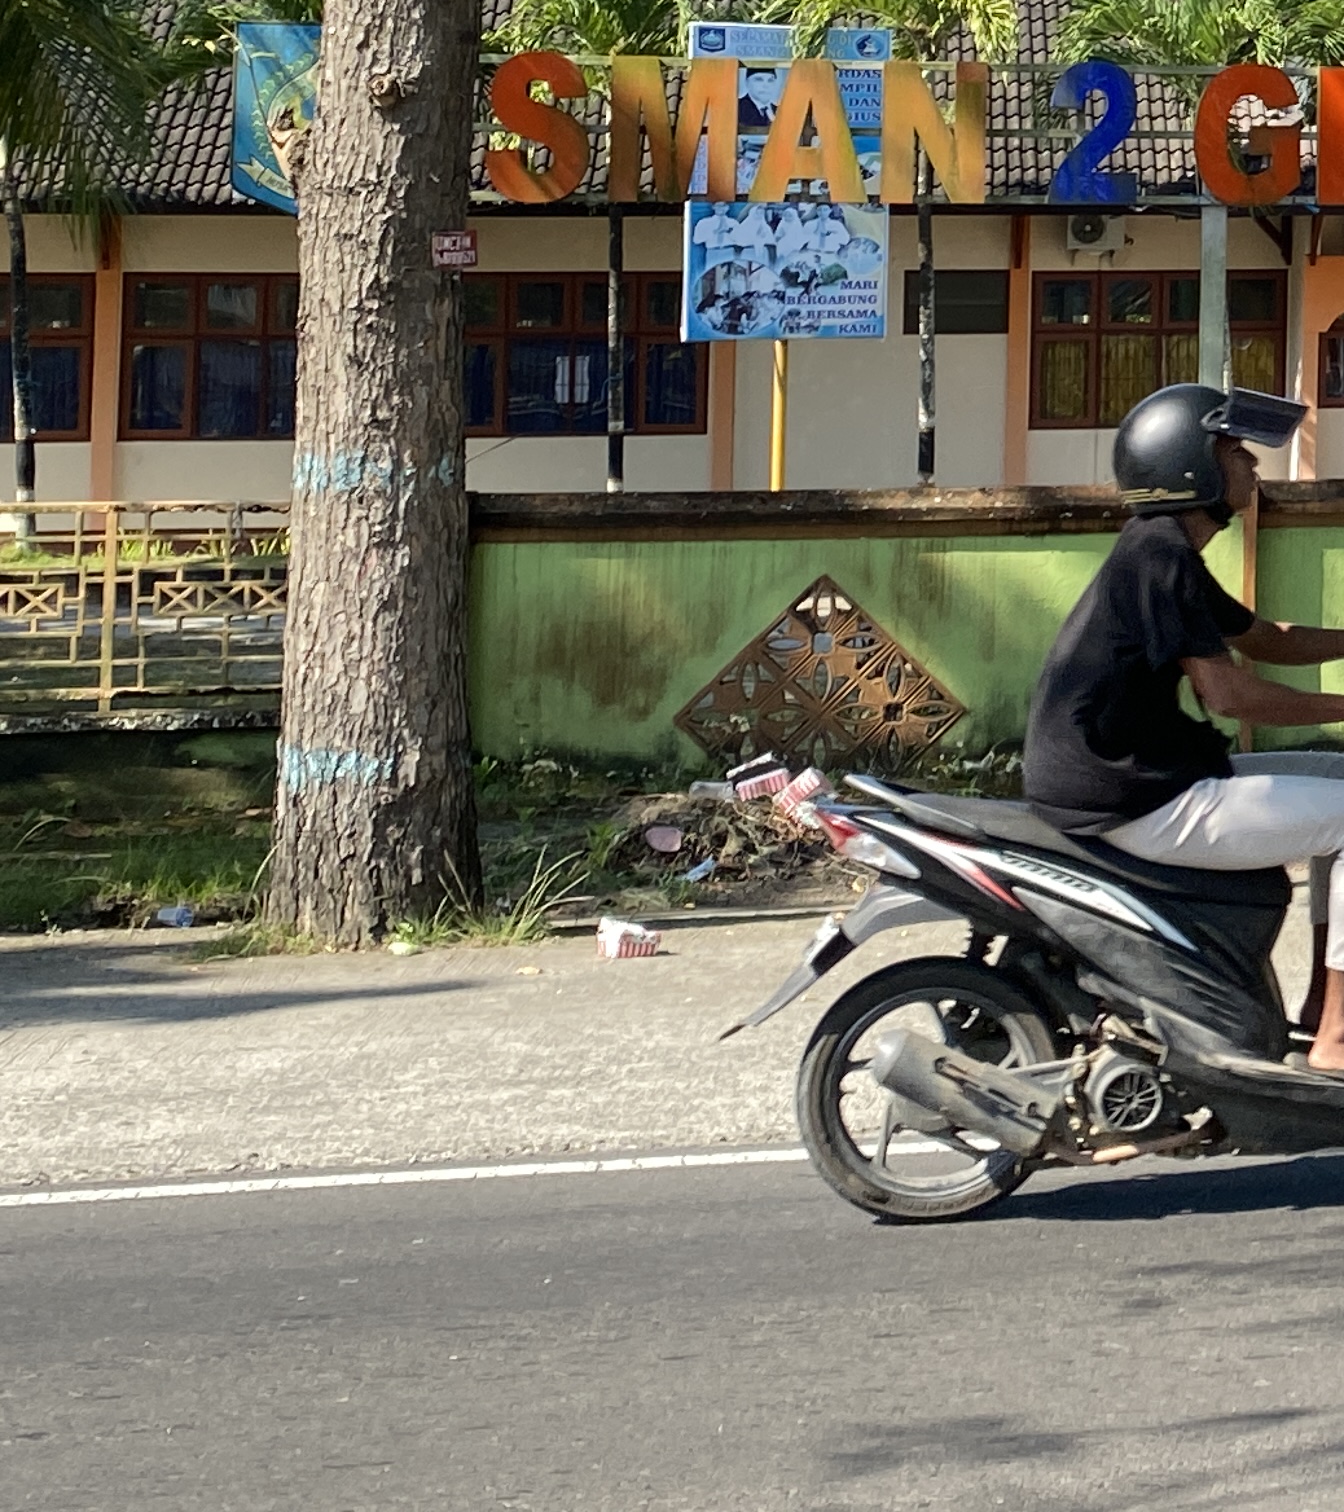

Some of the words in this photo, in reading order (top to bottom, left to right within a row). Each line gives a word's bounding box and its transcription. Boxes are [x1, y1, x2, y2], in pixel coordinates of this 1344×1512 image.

[838, 69, 881, 79] RDAS
[848, 98, 881, 107] DAN
[485, 50, 987, 204] SMAN
[1048, 59, 1138, 205] 2
[839, 280, 879, 291] MARI
[787, 294, 878, 306] BERGABUNG
[806, 309, 878, 320] BERSAMA
[838, 324, 878, 334] KAMI
